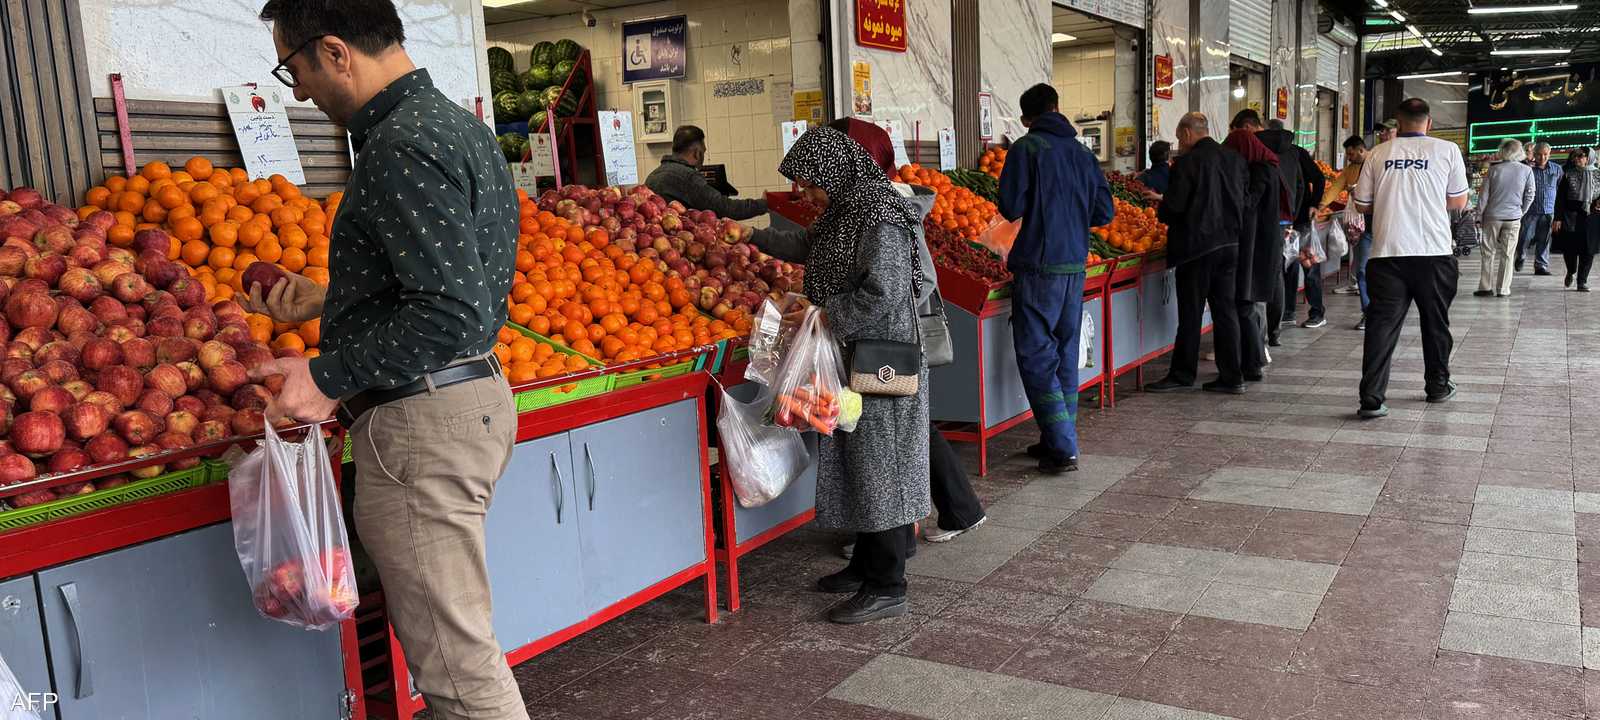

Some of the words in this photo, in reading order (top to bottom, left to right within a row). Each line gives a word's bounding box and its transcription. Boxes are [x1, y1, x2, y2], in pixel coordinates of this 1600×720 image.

[863, 13, 883, 38] نمونه
[885, 23, 902, 42] میوه
[1384, 159, 1429, 171] PEPSI
